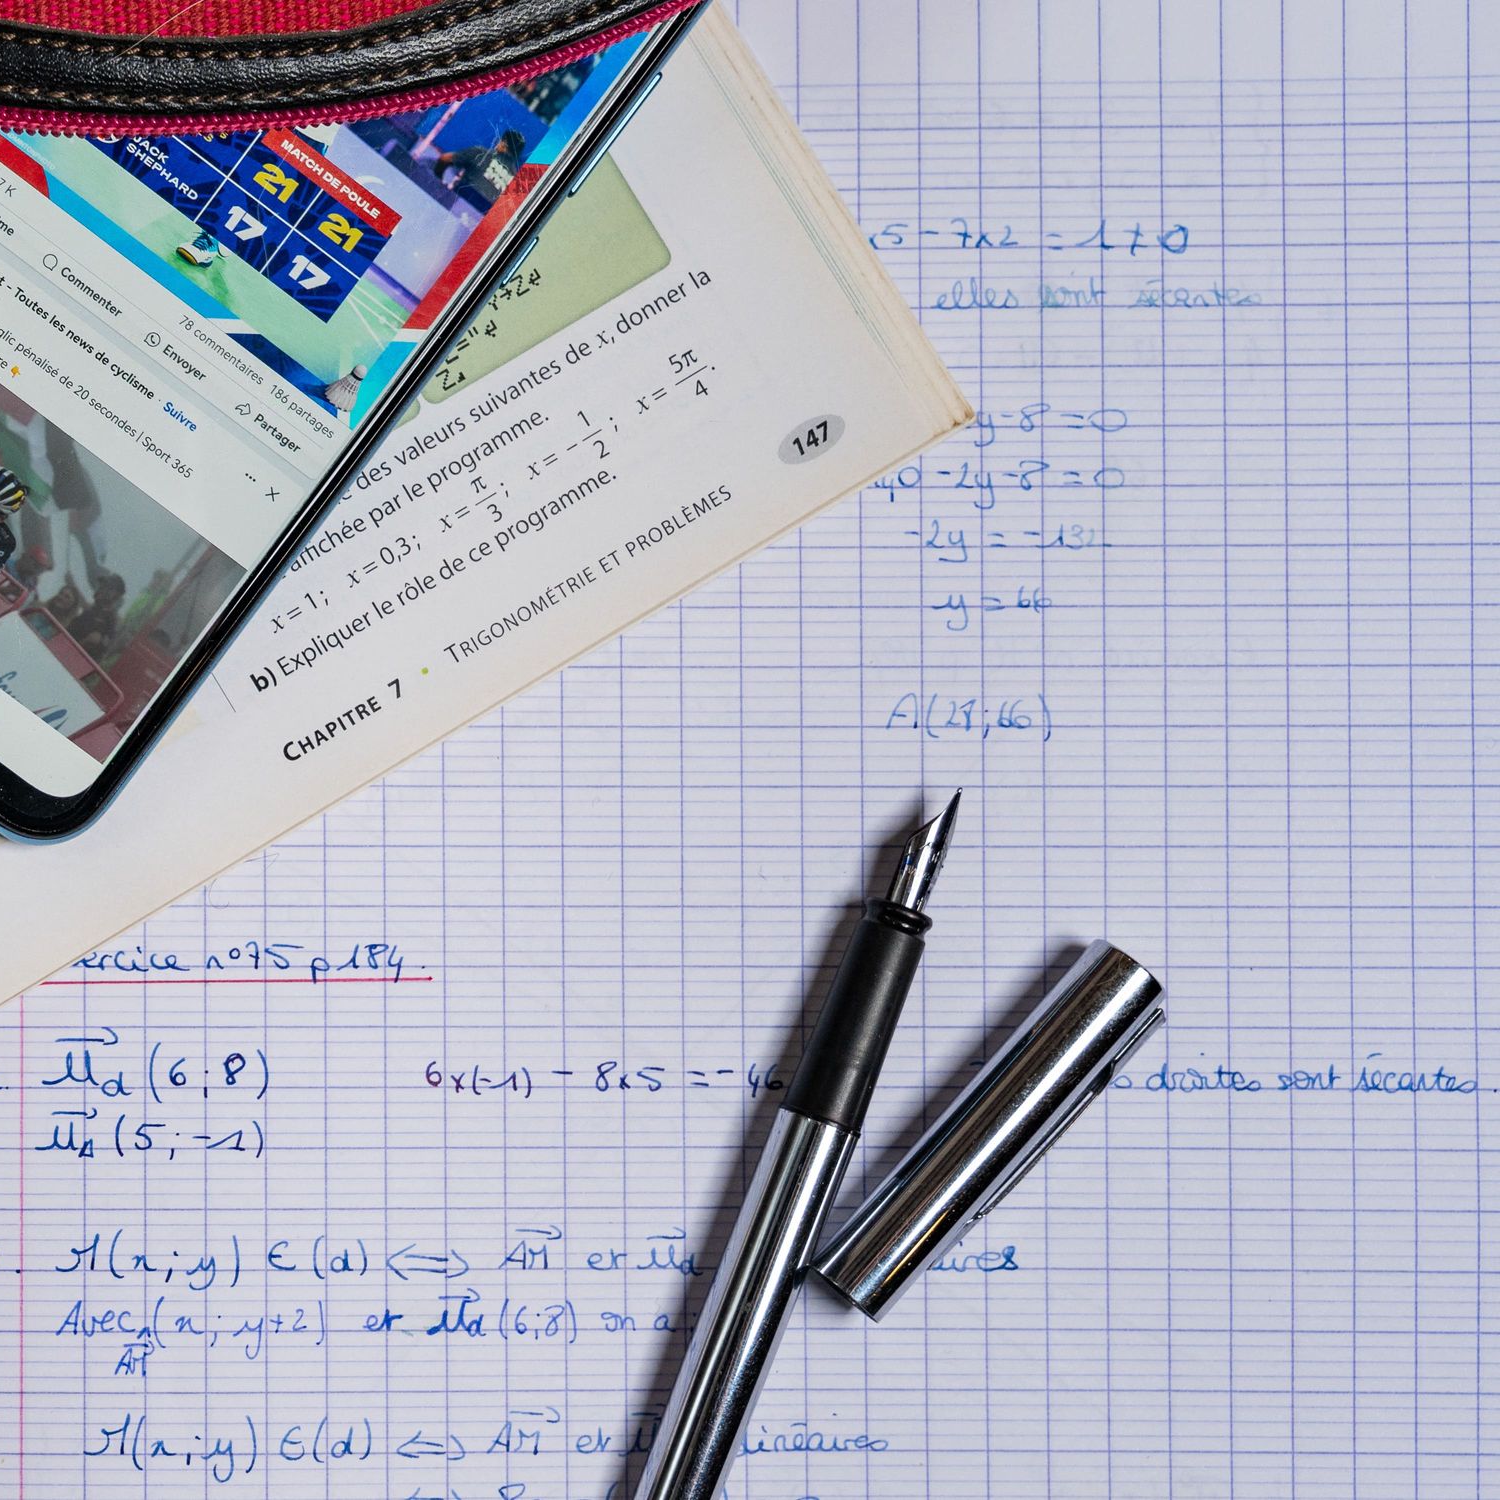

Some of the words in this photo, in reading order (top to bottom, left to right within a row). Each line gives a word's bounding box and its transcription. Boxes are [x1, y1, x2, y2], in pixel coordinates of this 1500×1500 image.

[5, 185, 17, 198] K
[126, 143, 199, 200] SHEPHARD
[253, 163, 299, 204] 21
[281, 140, 324, 176] MATCH
[323, 172, 341, 189] DE
[340, 184, 380, 219] POULE
[224, 205, 268, 241] 17
[318, 213, 364, 253] 21
[61, 267, 123, 317] Commenter
[288, 254, 332, 290] 17
[14, 287, 50, 320] Toutes
[49, 315, 66, 333] les
[66, 330, 95, 354] news
[95, 352, 110, 366] de
[110, 364, 155, 400] cyclisme
[163, 344, 207, 381] Envoyer
[179, 315, 195, 331] 78
[194, 330, 264, 385] commentaires
[356, 461, 392, 491] des
[394, 417, 466, 466] valeurs
[470, 360, 562, 423] suivantes
[566, 343, 593, 365] de
[617, 283, 687, 334] donner
[688, 271, 712, 290] la
[14, 343, 60, 378] pénalisé
[59, 376, 74, 390] de
[73, 385, 90, 401] 20
[89, 398, 137, 438] secondes
[142, 437, 172, 464] Sport
[171, 459, 194, 479] 365
[163, 402, 197, 432] Suivre
[270, 385, 290, 404] 186
[287, 402, 335, 439] partages
[254, 413, 301, 453] Partager
[791, 420, 831, 456] 147
[250, 667, 278, 693] b)
[277, 612, 371, 677] Expliquer
[372, 601, 395, 620] le
[397, 576, 437, 606] rôle
[439, 558, 467, 580] de
[469, 542, 493, 563] ce
[494, 471, 617, 552] programme.
[598, 550, 620, 574] ET
[387, 678, 401, 699] 7
[1277, 1064, 1341, 1091] sont
